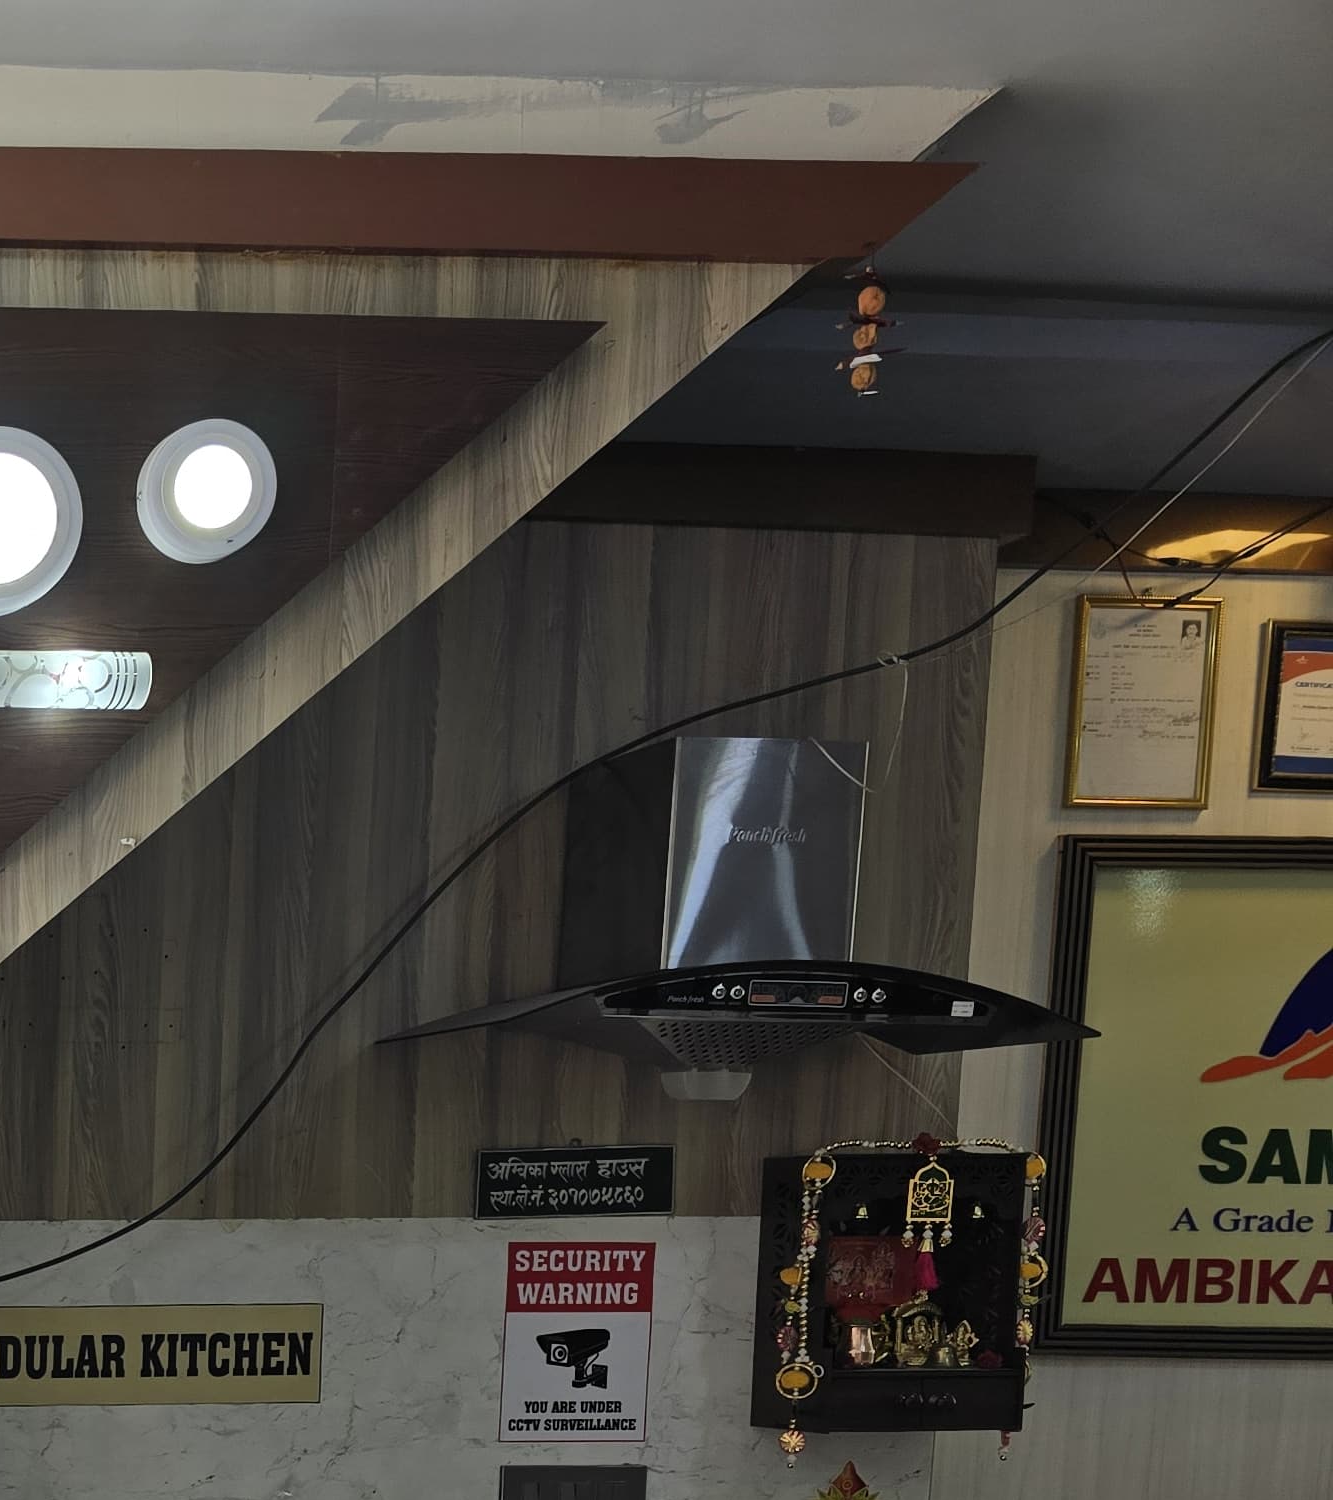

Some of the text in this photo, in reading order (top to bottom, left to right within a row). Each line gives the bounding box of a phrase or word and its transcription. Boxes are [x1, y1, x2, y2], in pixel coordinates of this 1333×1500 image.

[596, 1157, 649, 1179] हाउस
[1170, 1207, 1199, 1232] A
[1213, 1207, 1314, 1233] Grade
[515, 1249, 646, 1272] SECURITY
[1083, 1258, 1333, 1304] AMBIKA
[517, 1282, 638, 1305] WARNING
[140, 1331, 314, 1378] KITCHEN
[524, 1401, 621, 1413] YOU ARE UNDER
[508, 1419, 636, 1431] CCTV SURVEILLANCE
